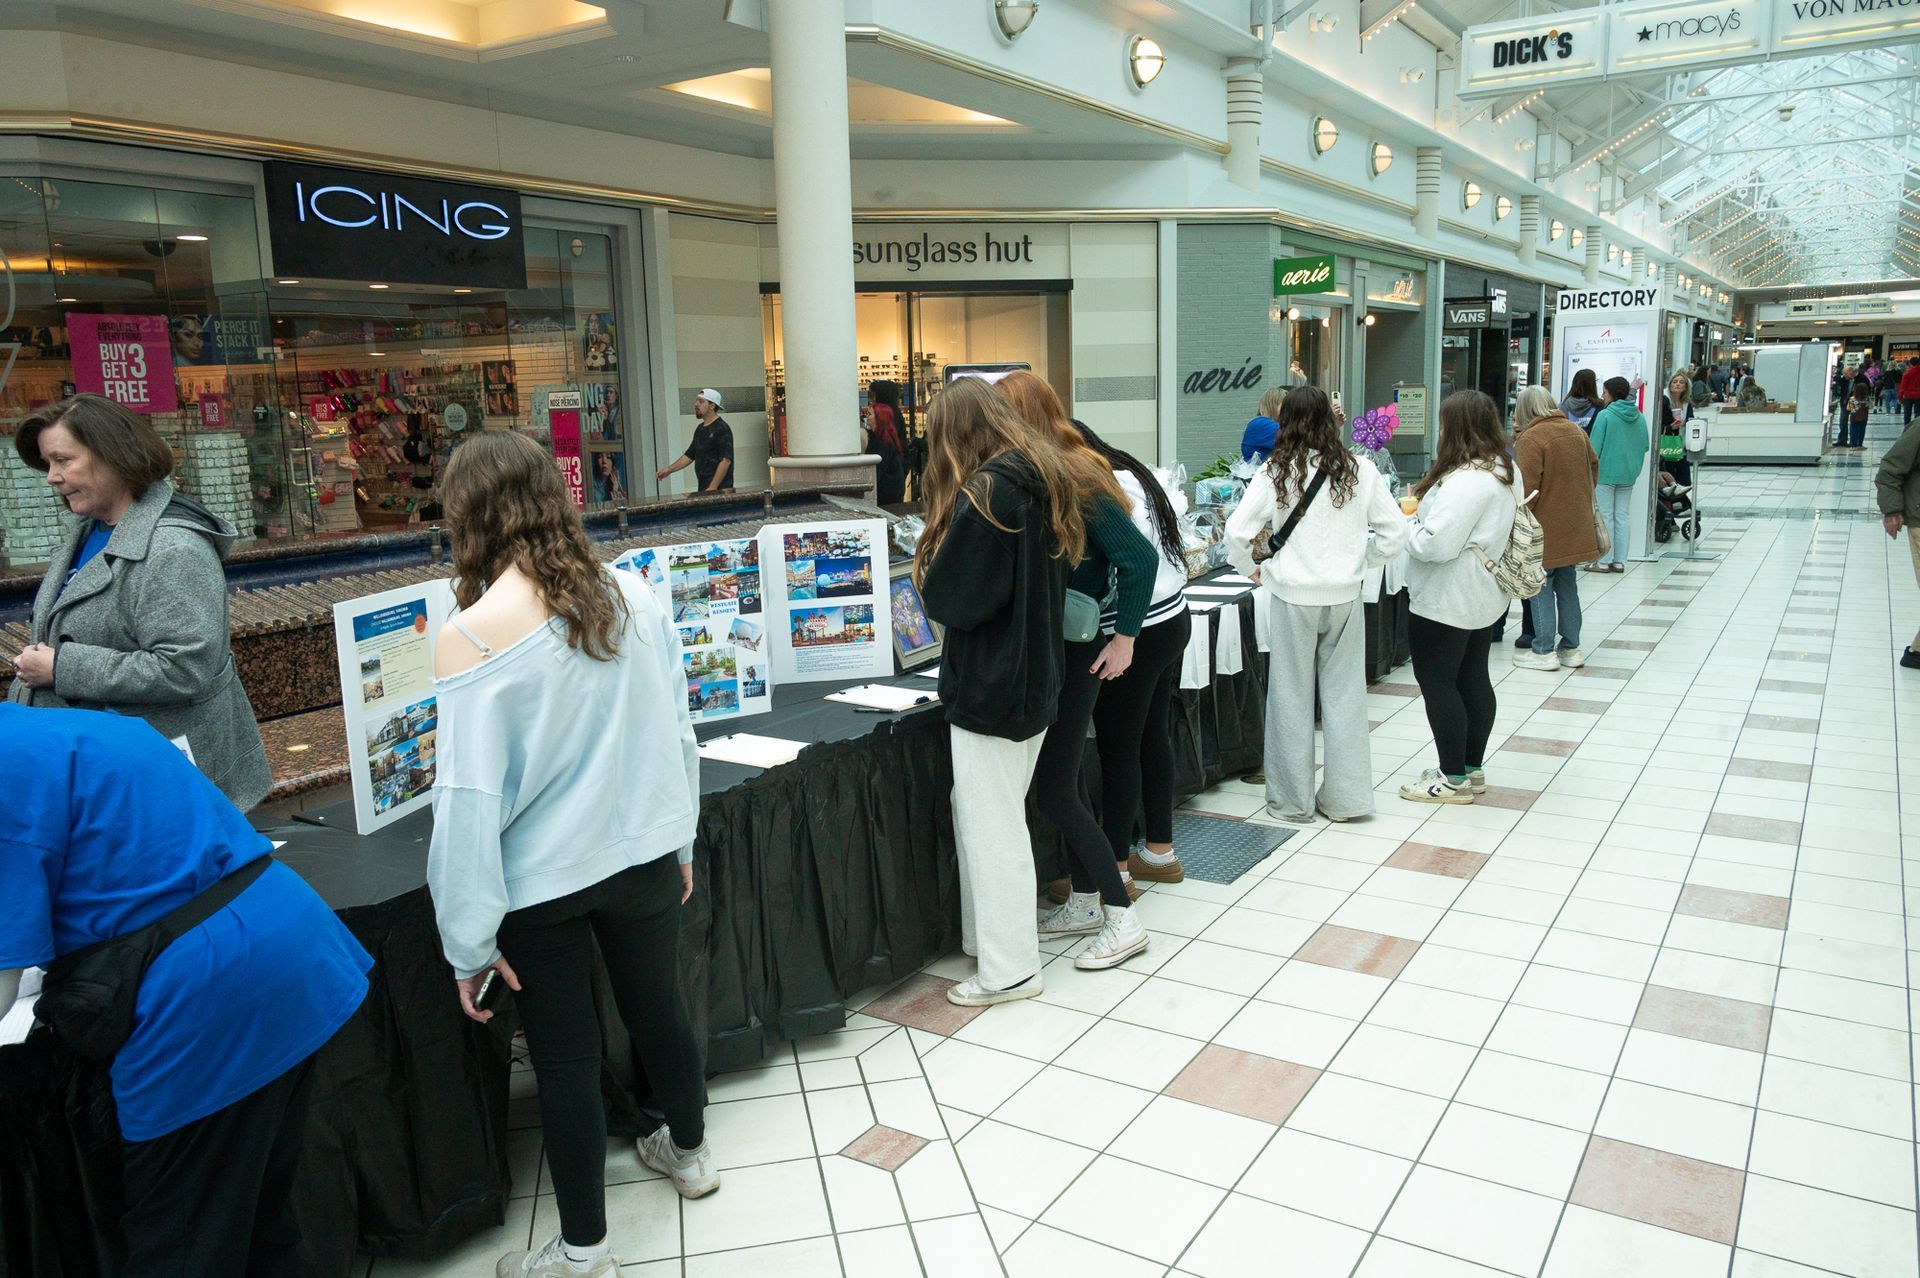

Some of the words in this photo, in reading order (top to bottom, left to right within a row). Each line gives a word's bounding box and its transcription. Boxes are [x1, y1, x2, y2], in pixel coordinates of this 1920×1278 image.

[1792, 0, 1844, 20] VON
[1853, 0, 1920, 13] MA
[1655, 8, 1741, 41] macy's
[1493, 29, 1573, 68] DICK'S
[296, 182, 511, 240] ICING
[853, 232, 978, 272] sunglass
[985, 232, 1033, 263] hut
[1281, 261, 1330, 286] aerie
[1560, 289, 1657, 311] DIRECTORY
[214, 321, 248, 334] PIERCE
[250, 320, 259, 333] IT
[1450, 309, 1486, 323] VANS
[217, 335, 248, 348] STACK
[99, 344, 127, 361] BUY
[128, 343, 147, 379] 3
[101, 361, 128, 379] GET
[1183, 356, 1263, 394] aerie
[103, 381, 150, 403] FREE
[571, 456, 583, 486] 3
[565, 487, 583, 505] REE
